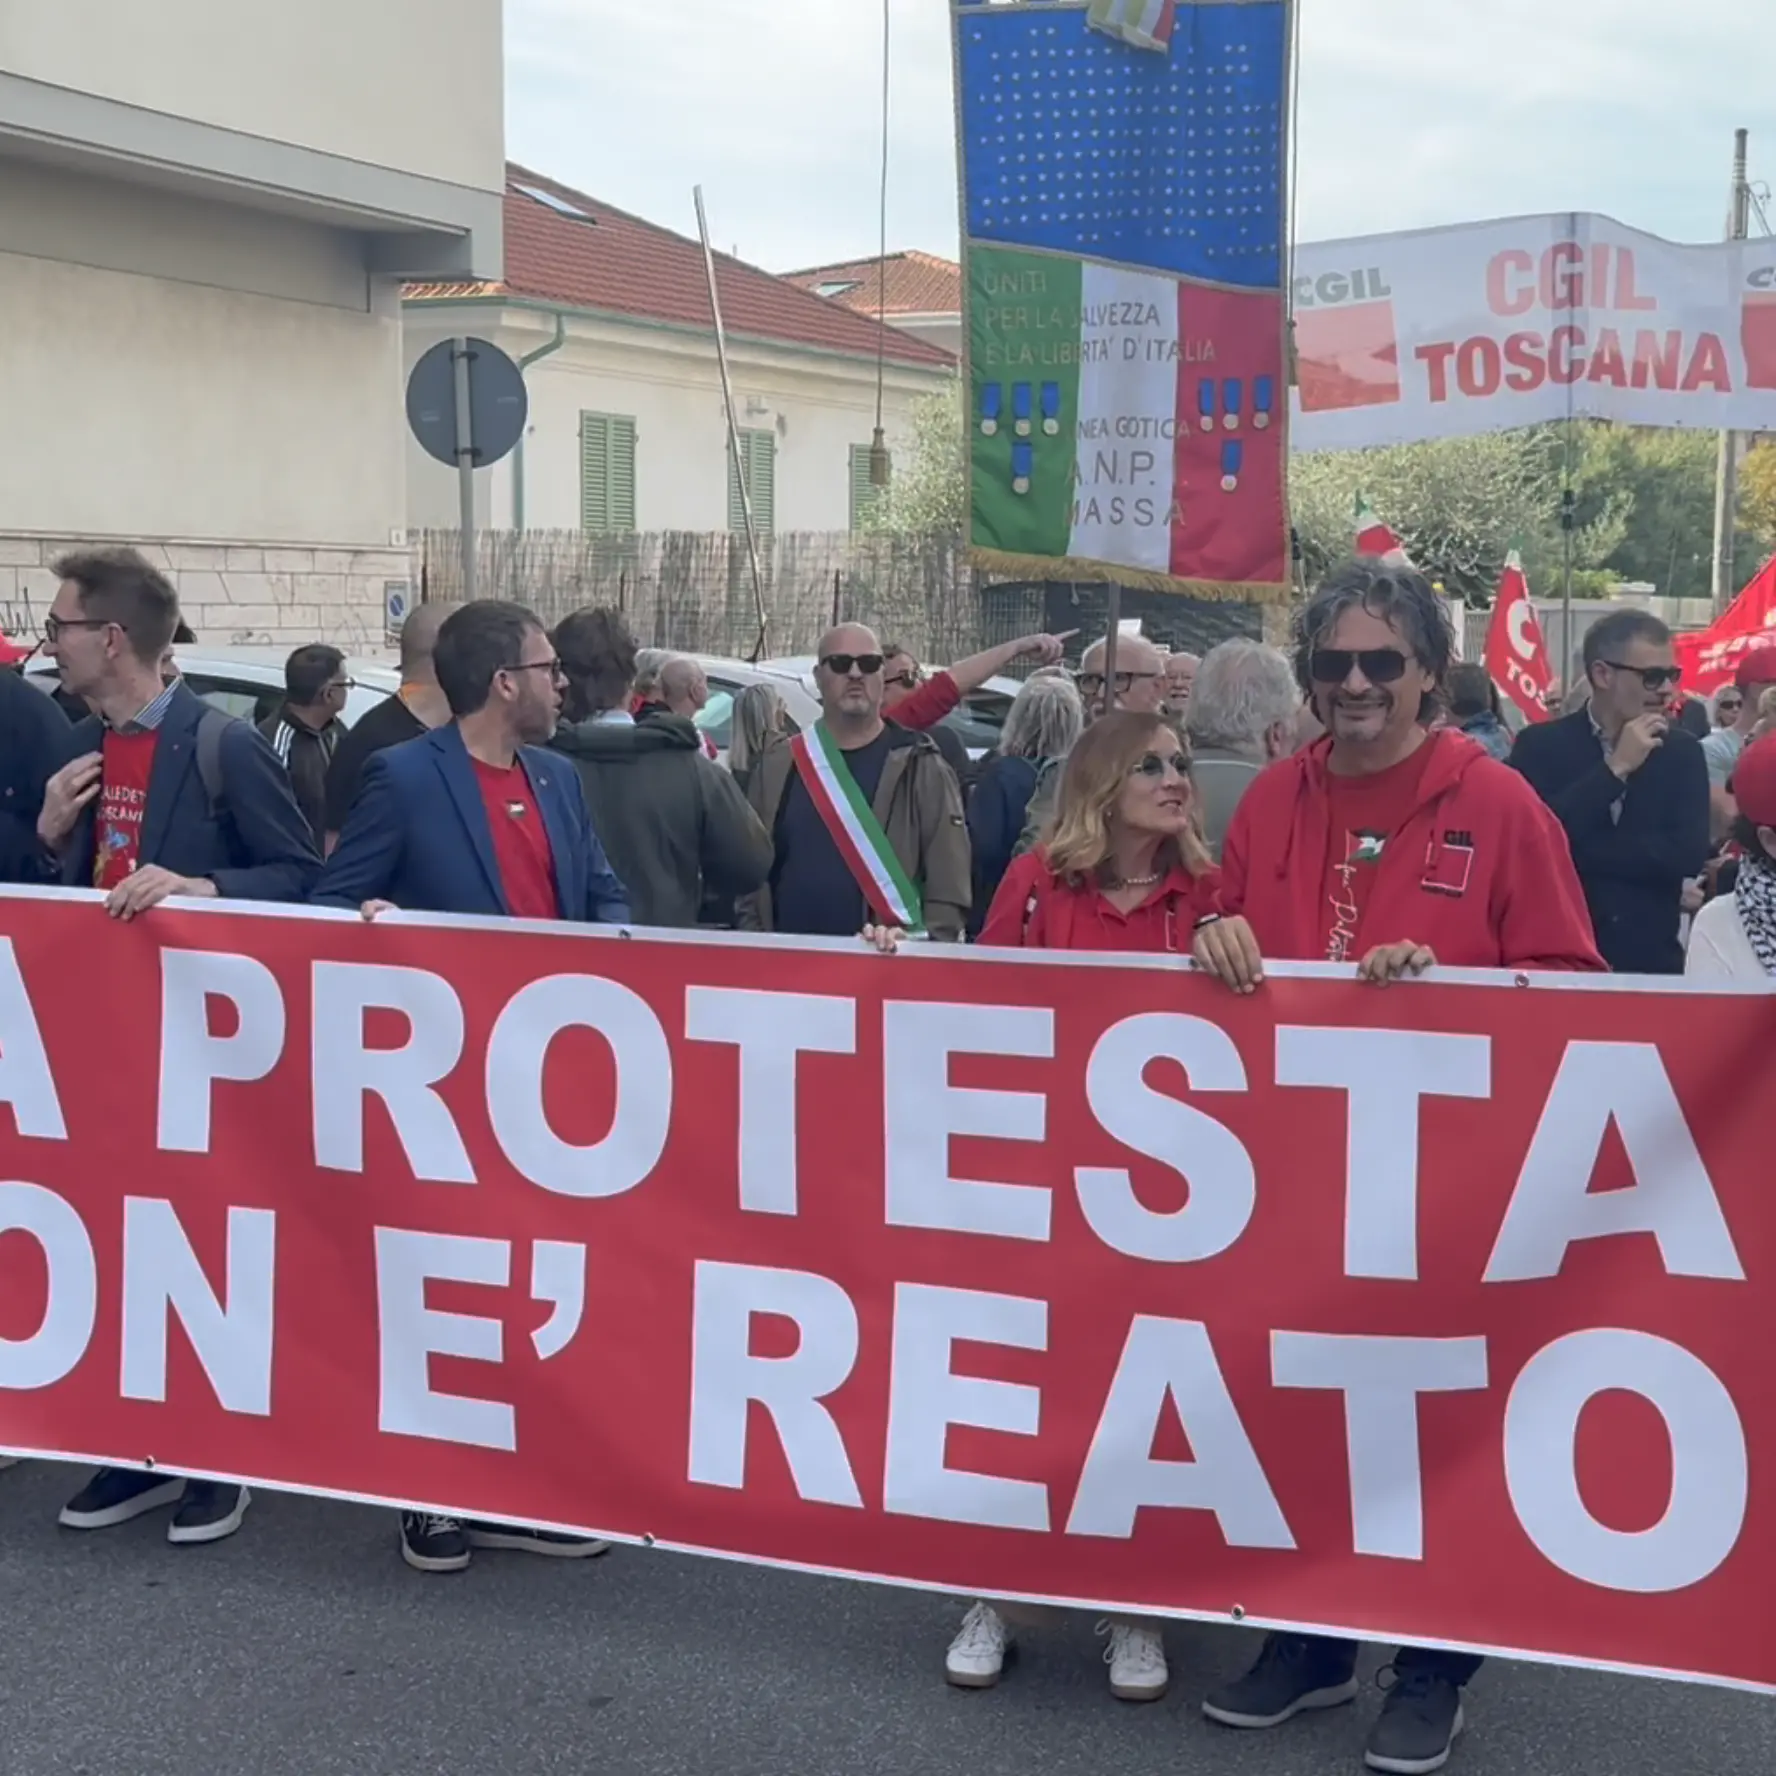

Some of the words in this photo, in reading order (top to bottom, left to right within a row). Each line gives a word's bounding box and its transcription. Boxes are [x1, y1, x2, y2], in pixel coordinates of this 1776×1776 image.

[984, 269, 1047, 295] UNITI
[1293, 267, 1392, 306] CGIL
[1485, 241, 1658, 317] CGIL
[984, 306, 1029, 331] PER
[1036, 306, 1063, 330] LA
[1414, 325, 1733, 403] TOSCANA
[1115, 415, 1191, 441] GOTICA
[156, 945, 1747, 1284] PROTESTA
[686, 1259, 1750, 1595] REATO
